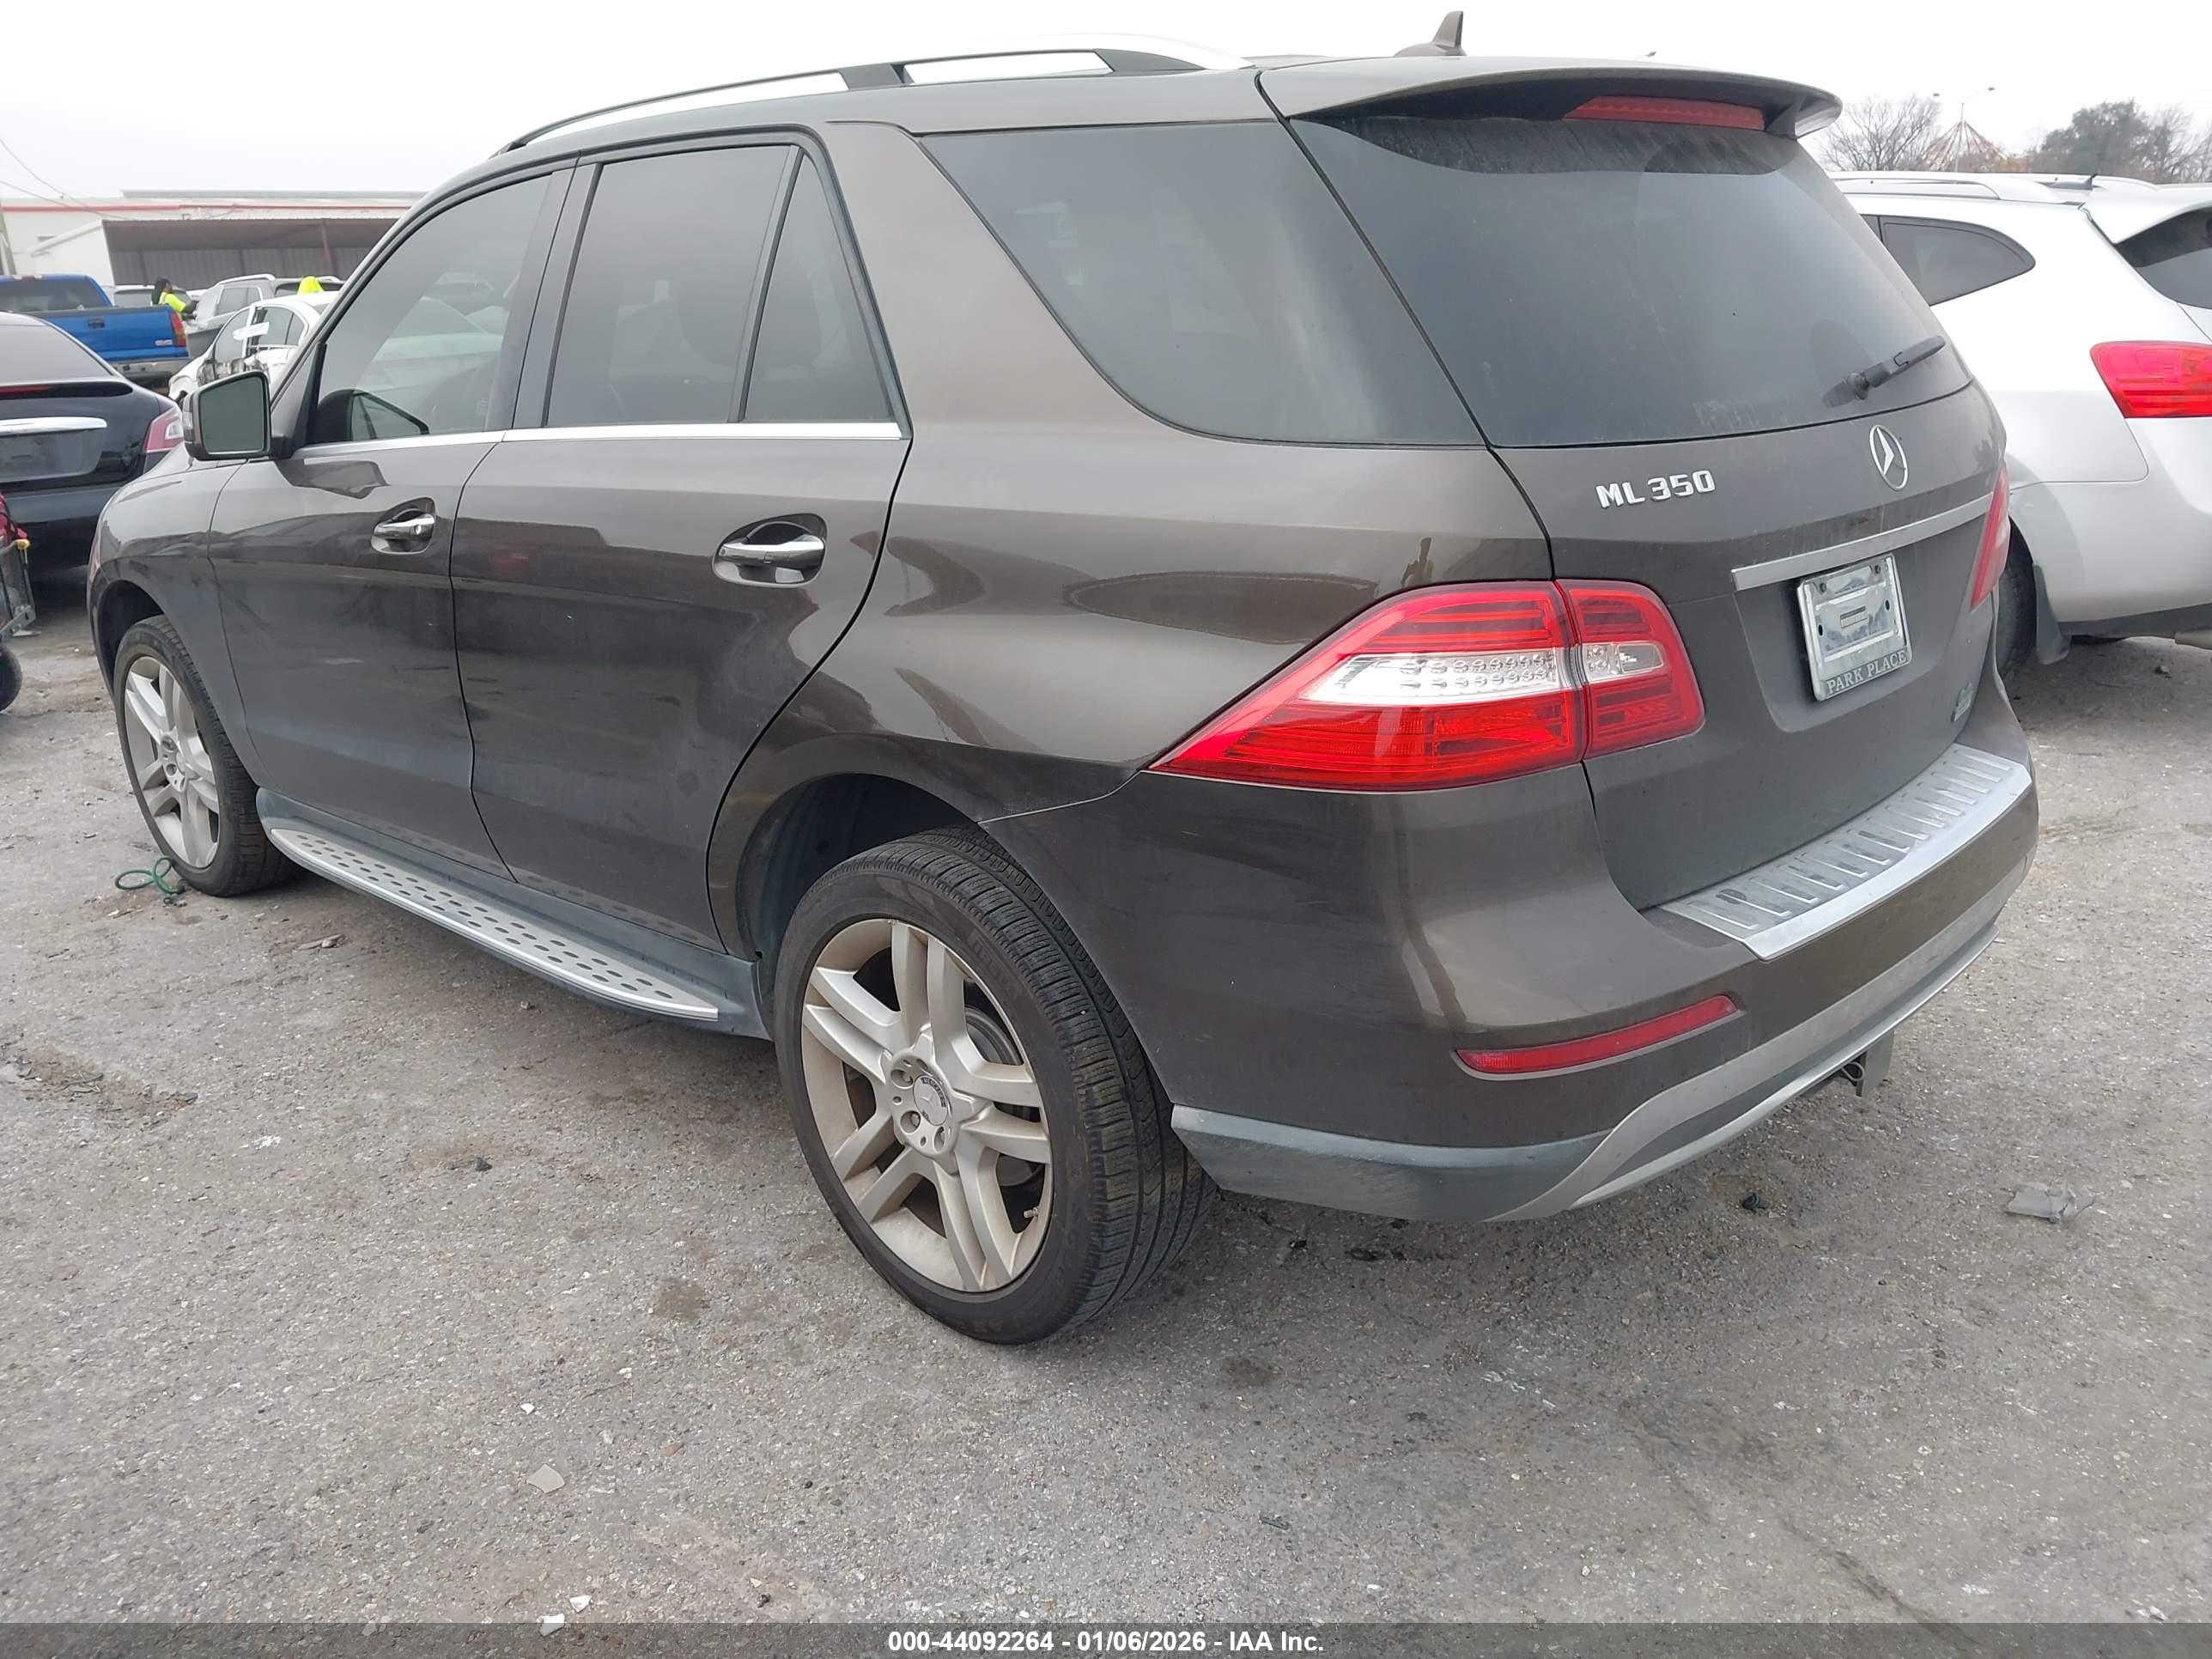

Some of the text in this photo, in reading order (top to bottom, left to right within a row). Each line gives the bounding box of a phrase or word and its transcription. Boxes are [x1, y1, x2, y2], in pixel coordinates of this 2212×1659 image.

[1595, 470, 1716, 509] ML 350
[1826, 649, 1907, 695] PARK PLACE
